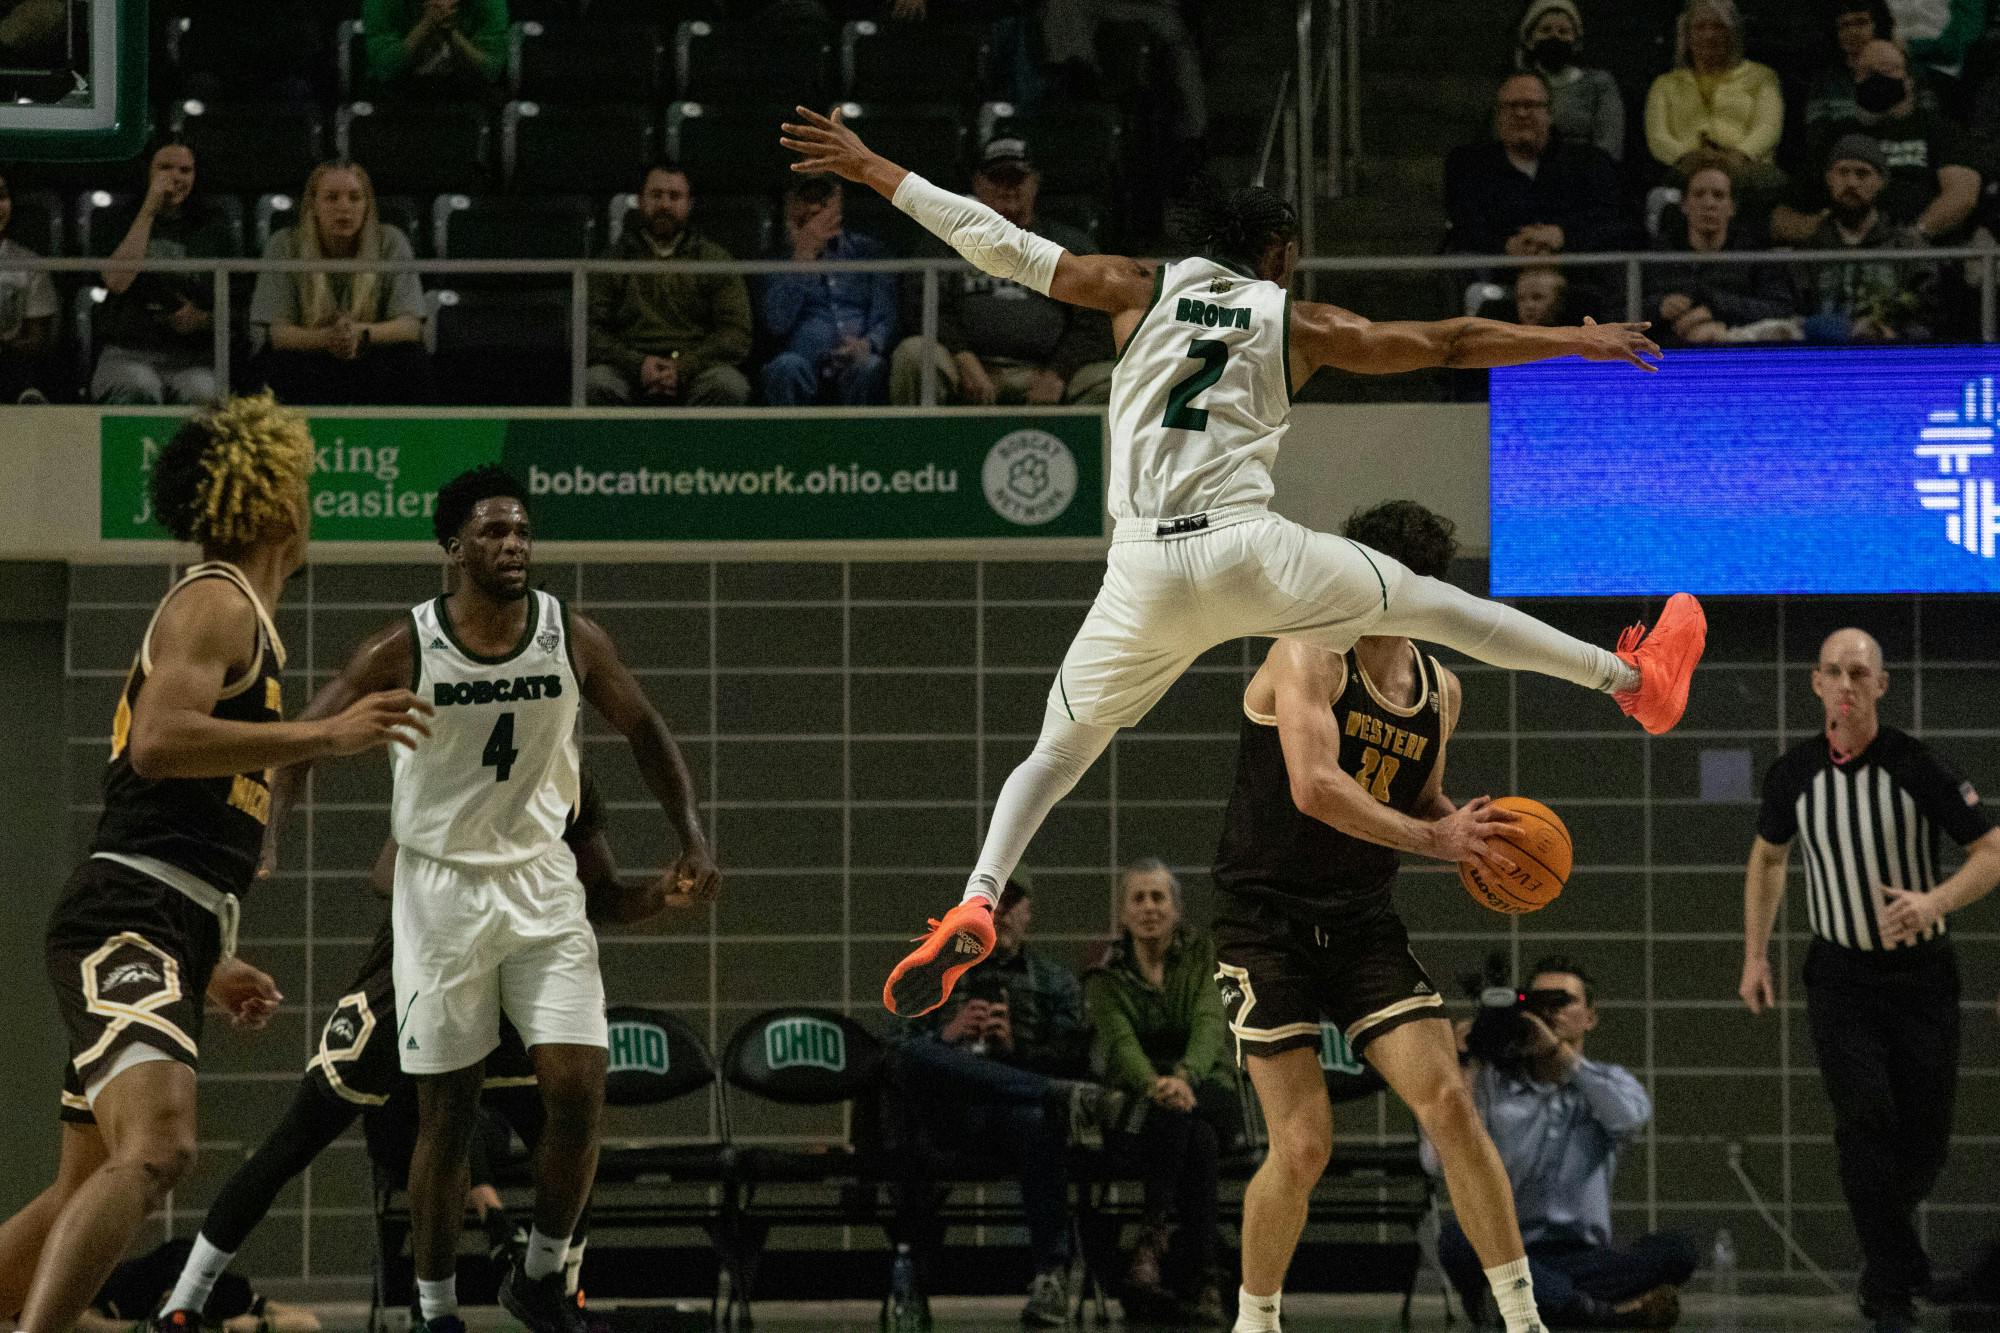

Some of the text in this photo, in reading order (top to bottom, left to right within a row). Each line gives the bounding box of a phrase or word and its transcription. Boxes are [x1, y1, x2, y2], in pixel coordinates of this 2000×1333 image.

[1175, 297, 1252, 330] BROWN
[1161, 338, 1229, 432] 2
[313, 481, 439, 518] easier
[529, 463, 958, 496] bobcatnetwork.ohio.edu
[433, 674, 563, 707] BOBCATS
[482, 712, 519, 783] 4
[1344, 710, 1429, 761] WESTERN
[609, 1023, 668, 1073] HIO
[767, 1018, 844, 1071] OHIO
